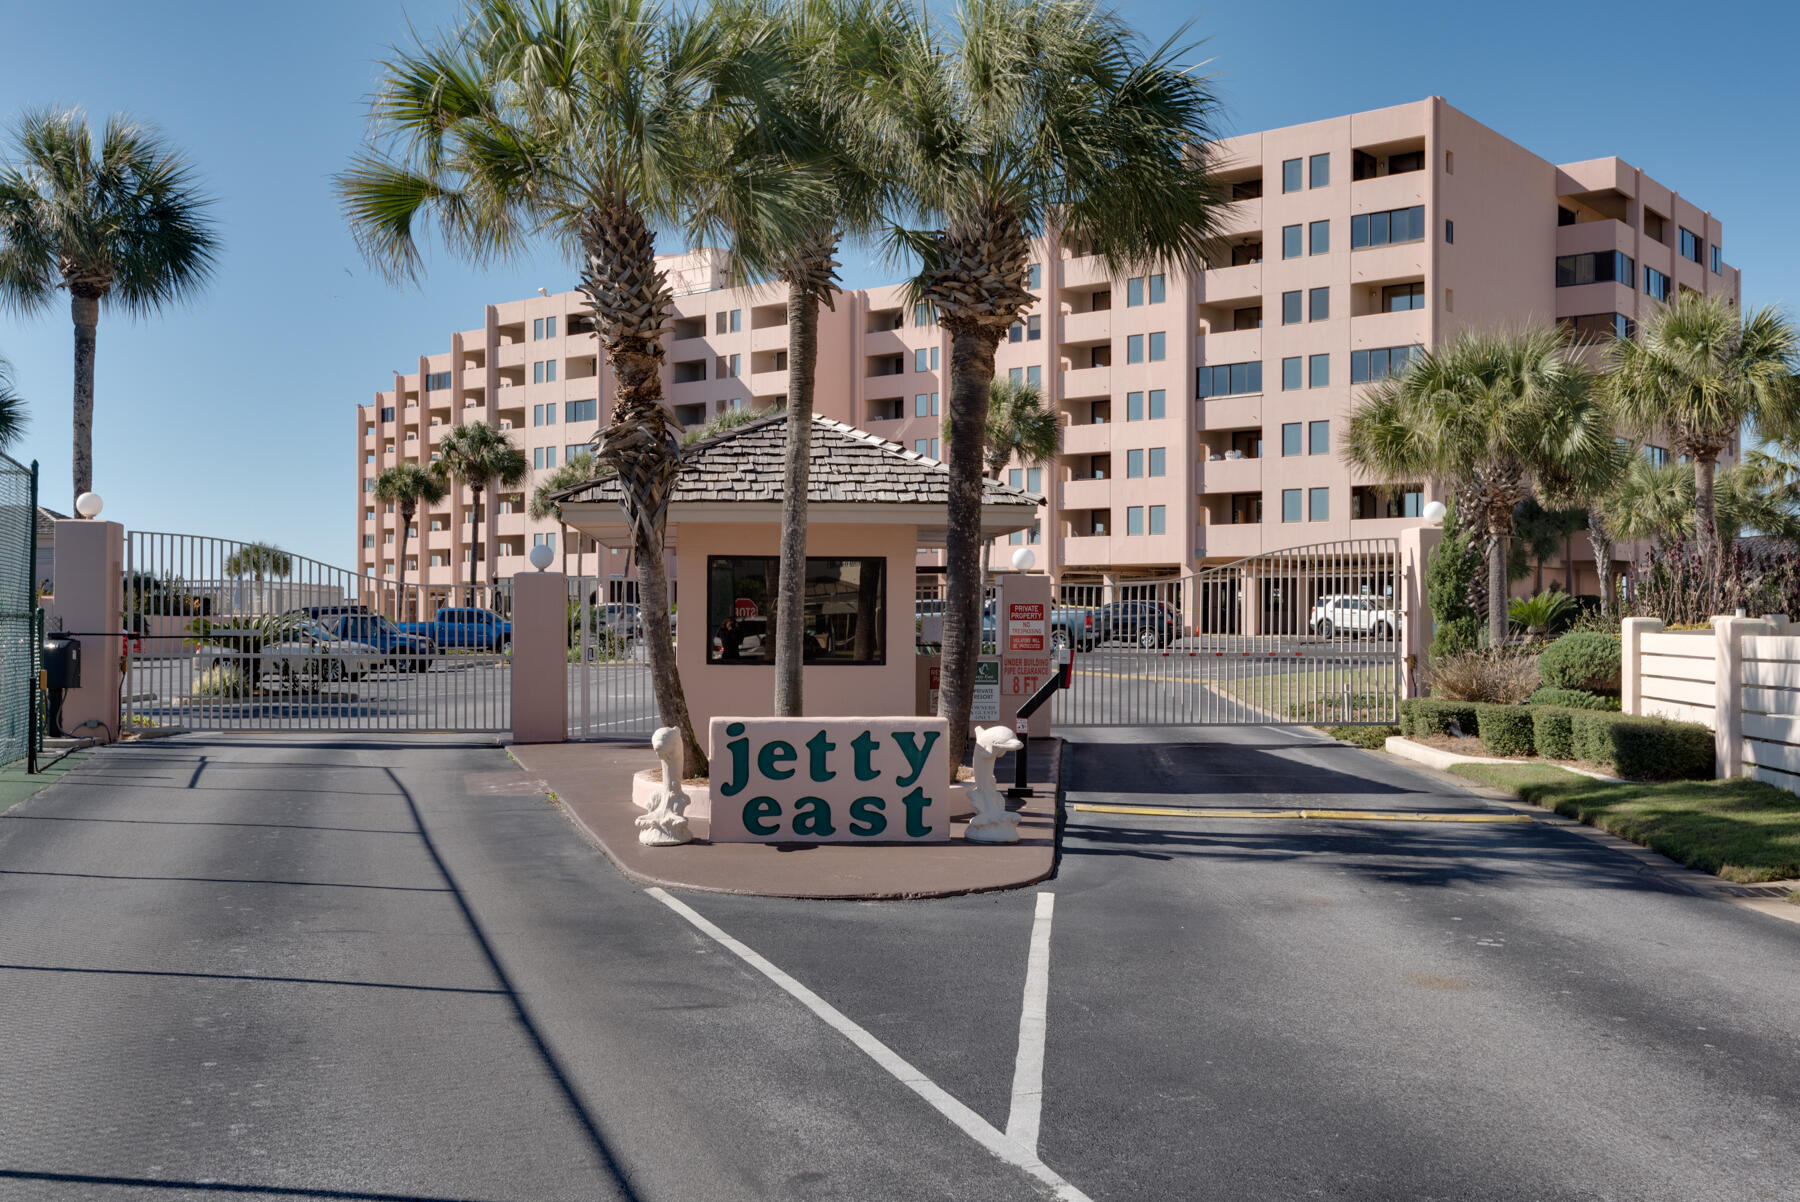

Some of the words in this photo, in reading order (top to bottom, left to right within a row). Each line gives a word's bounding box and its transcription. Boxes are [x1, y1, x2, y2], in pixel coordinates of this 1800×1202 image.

[1004, 658, 1023, 666] UNDER
[1024, 658, 1048, 666] BUILDING
[1004, 667, 1016, 675] PIPE
[1017, 667, 1048, 675] CLEARANCE
[1013, 676, 1020, 694] 8
[720, 721, 941, 797] jetty
[742, 786, 933, 838] east
